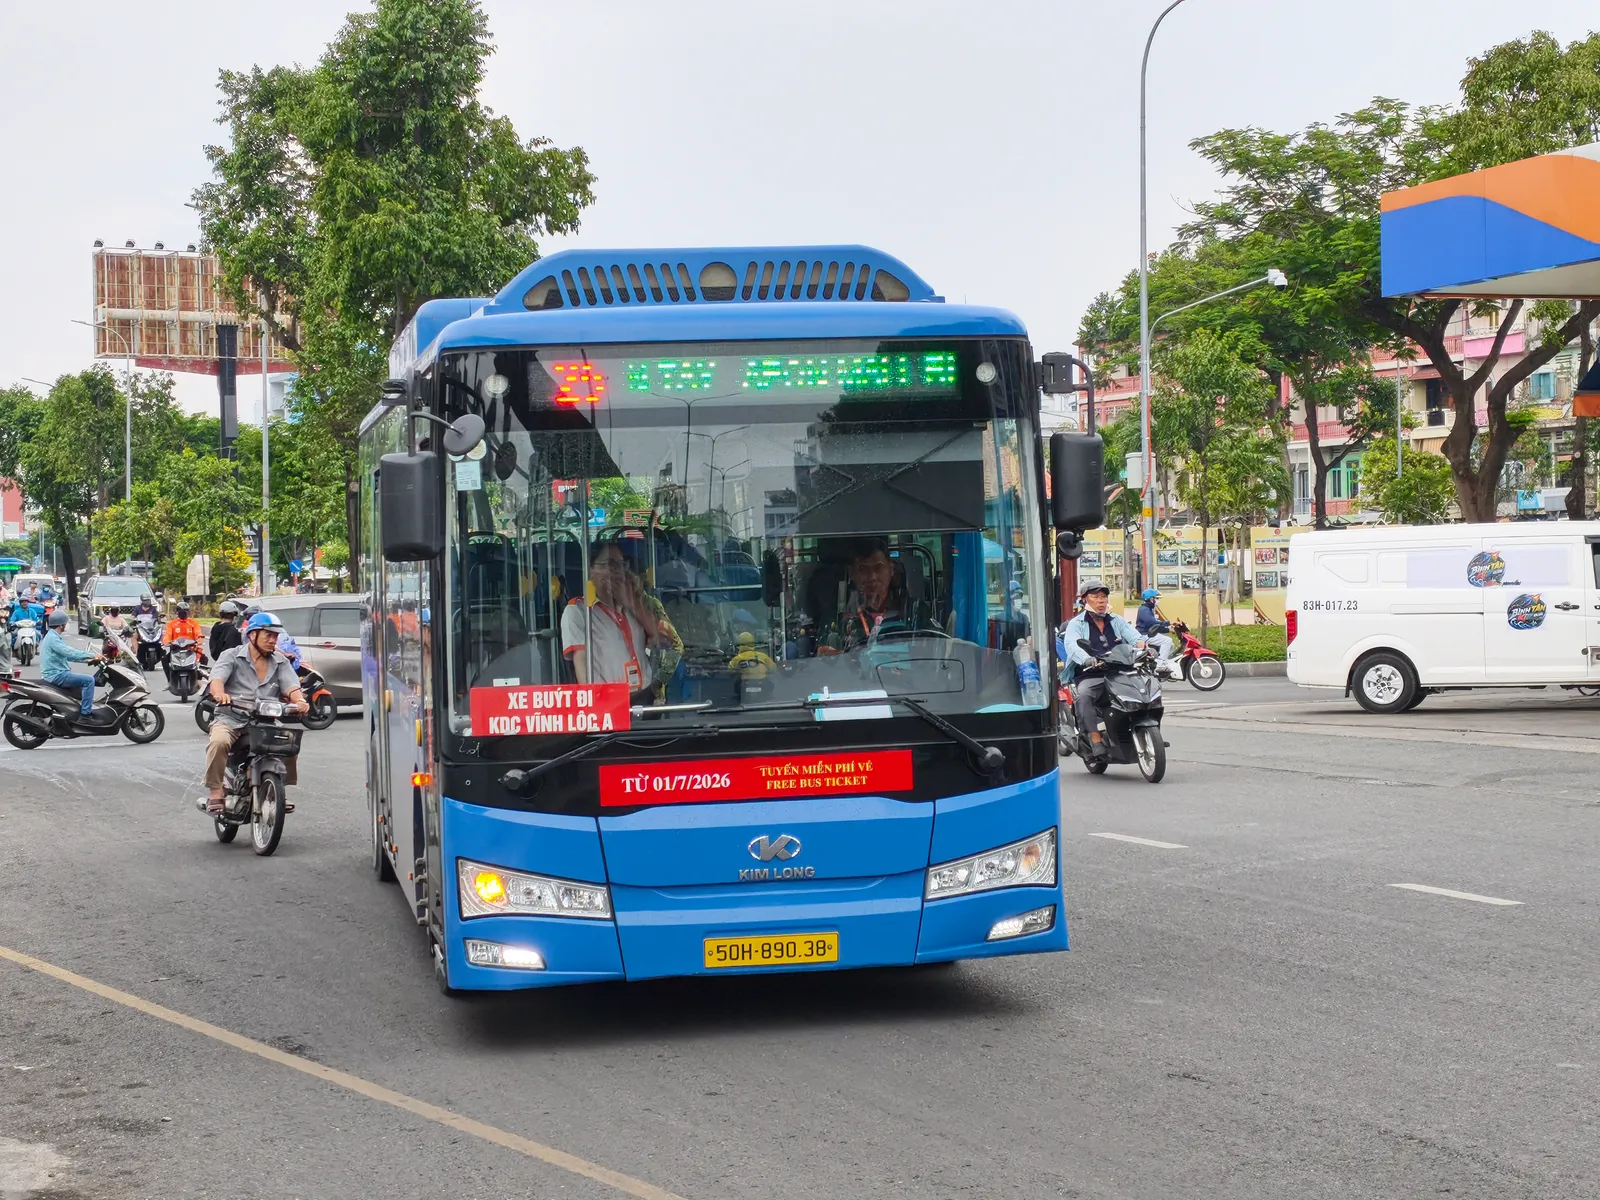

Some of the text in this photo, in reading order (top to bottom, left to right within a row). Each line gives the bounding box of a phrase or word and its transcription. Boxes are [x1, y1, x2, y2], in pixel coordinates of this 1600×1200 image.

[1303, 600, 1358, 611] 83H-017.23
[507, 687, 593, 710] XE BUÝT ĐI
[489, 716, 521, 734] KDC
[525, 712, 561, 733] VĨNH
[602, 713, 614, 731] A
[760, 762, 799, 777] TUYẾN
[835, 761, 855, 773] PHÍ
[858, 760, 873, 772] VÉ
[621, 772, 731, 793] TỪ 01/7/2026
[766, 775, 868, 790] FREE BUS TICKET
[738, 866, 816, 881] KIM LONG
[716, 939, 827, 962] 50H-890.38
